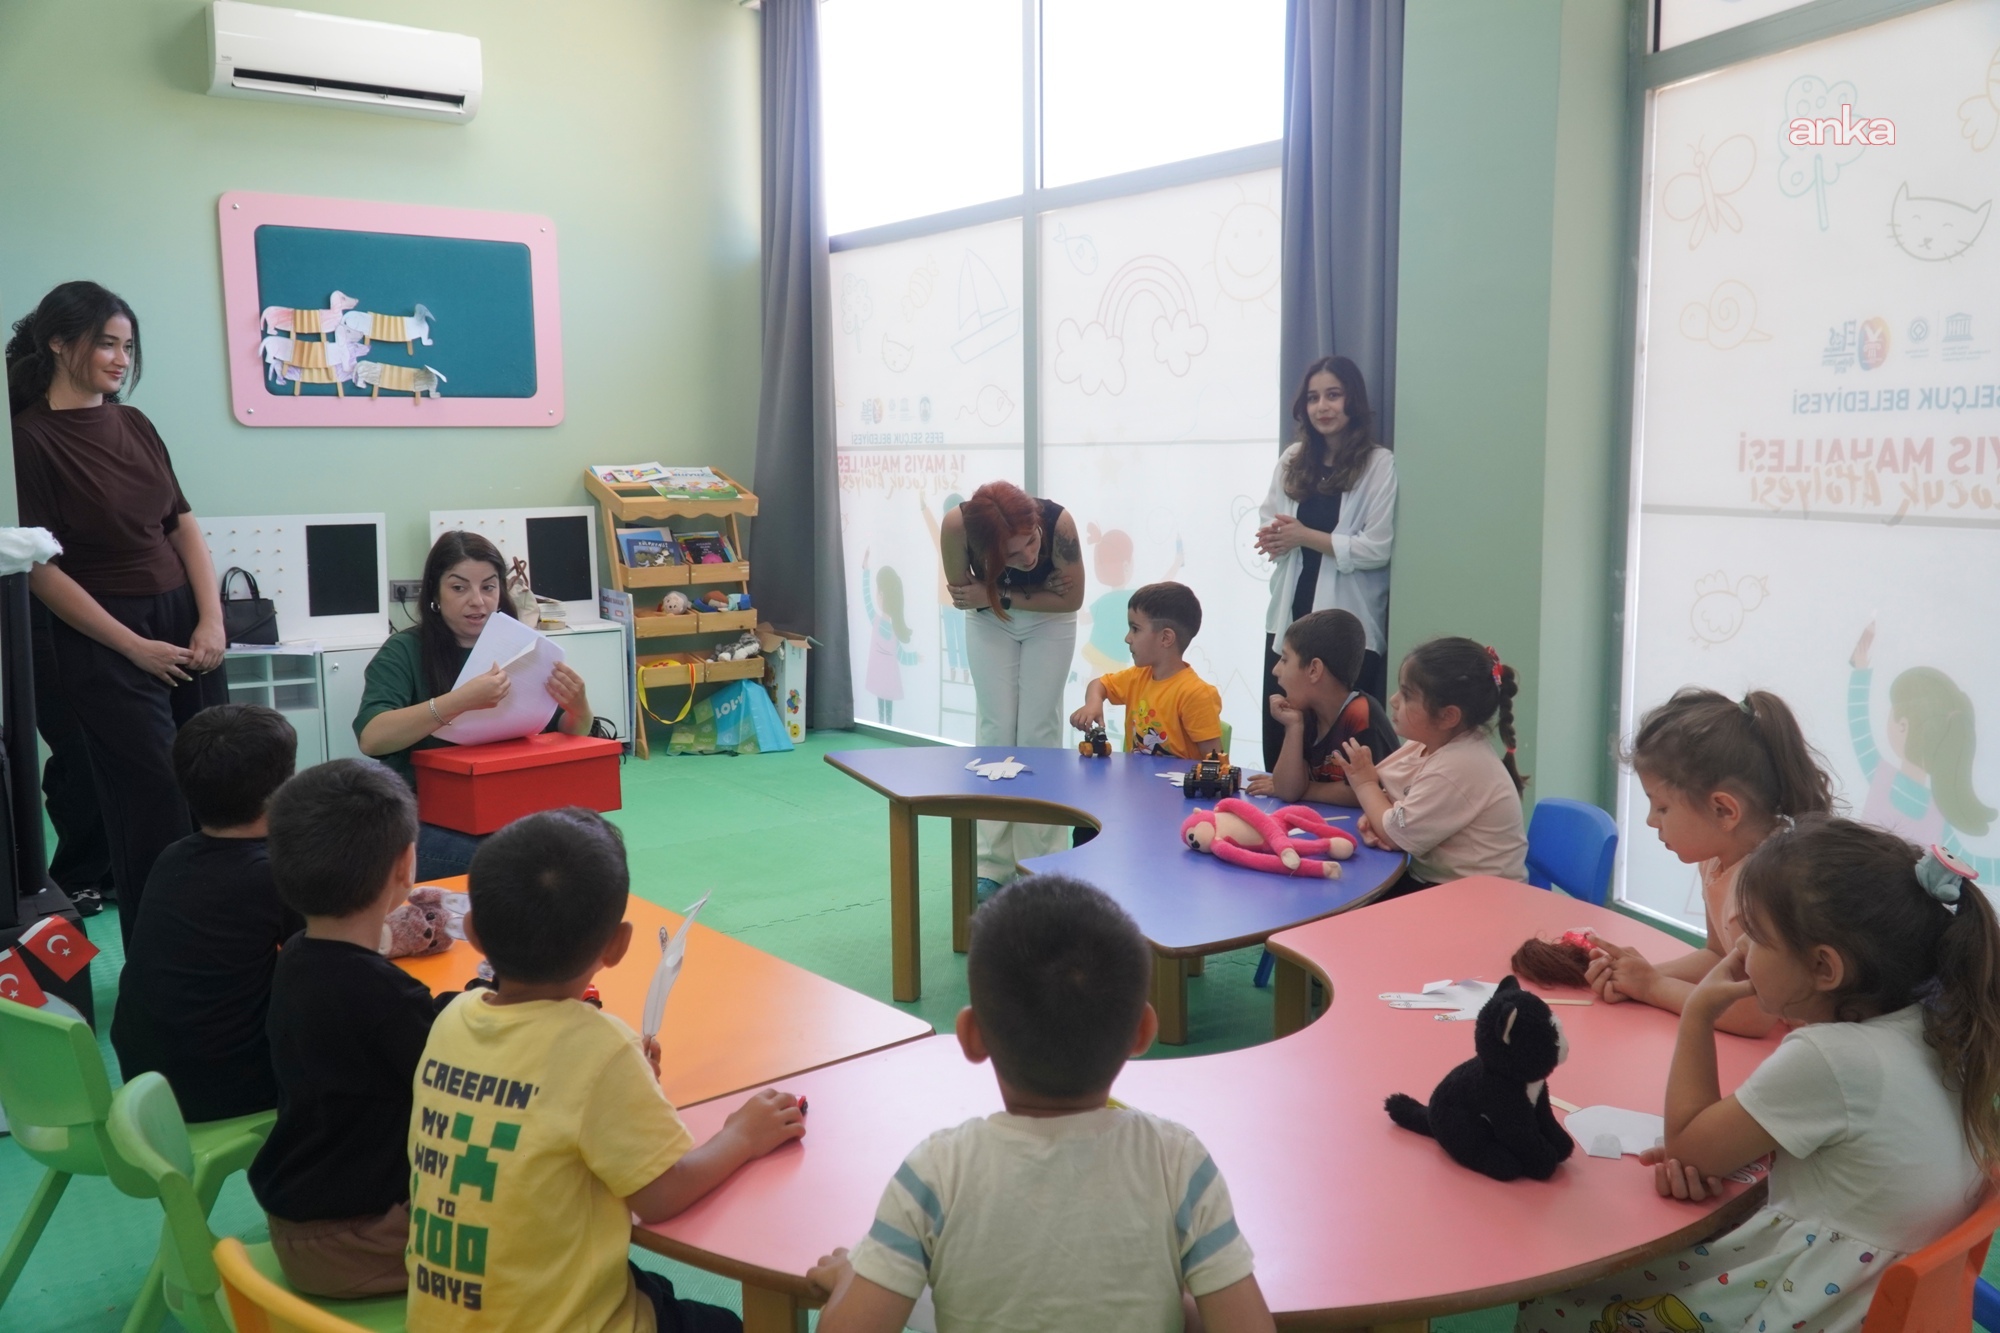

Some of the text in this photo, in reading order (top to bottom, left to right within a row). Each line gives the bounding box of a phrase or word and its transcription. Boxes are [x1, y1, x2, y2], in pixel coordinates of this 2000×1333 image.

[422, 1059, 540, 1110] CREEPIN'
[422, 1107, 449, 1139] MY
[414, 1143, 449, 1179] WAY
[437, 1198, 456, 1217] TO
[414, 1207, 489, 1277] 100
[417, 1263, 482, 1311] DAYS
